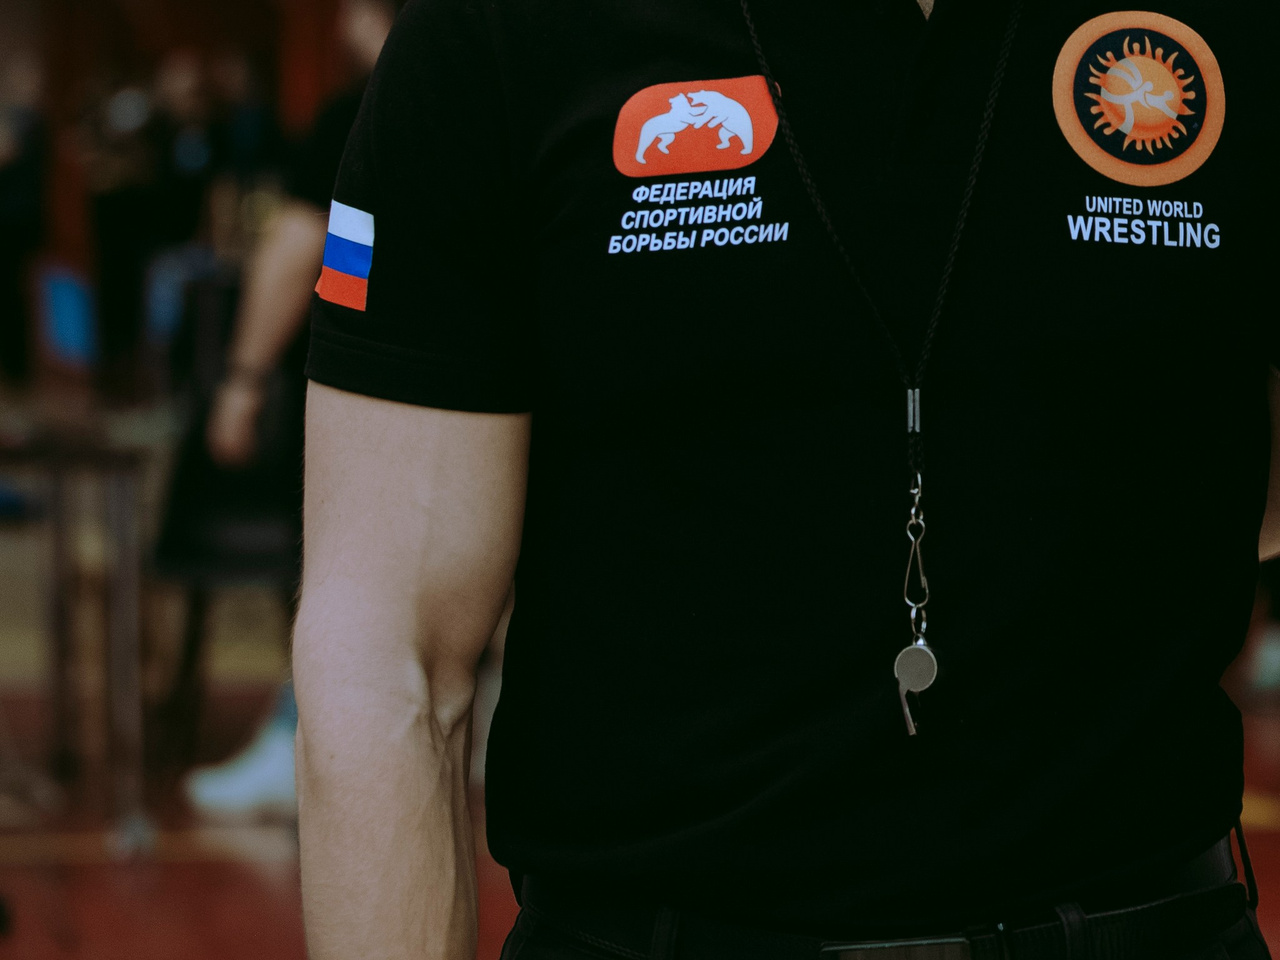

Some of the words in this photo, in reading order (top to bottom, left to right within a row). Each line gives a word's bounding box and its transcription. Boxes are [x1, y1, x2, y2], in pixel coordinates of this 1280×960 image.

[632, 176, 756, 205] ФЕДЕРАЦИЯ
[621, 197, 763, 229] СПОРТИВНОЙ
[1085, 195, 1143, 215] UNITED
[1147, 199, 1203, 219] WORLD
[608, 230, 696, 254] БОРЬБЫ
[700, 222, 789, 247] РОССИИ
[1067, 214, 1221, 249] WRESTLING
